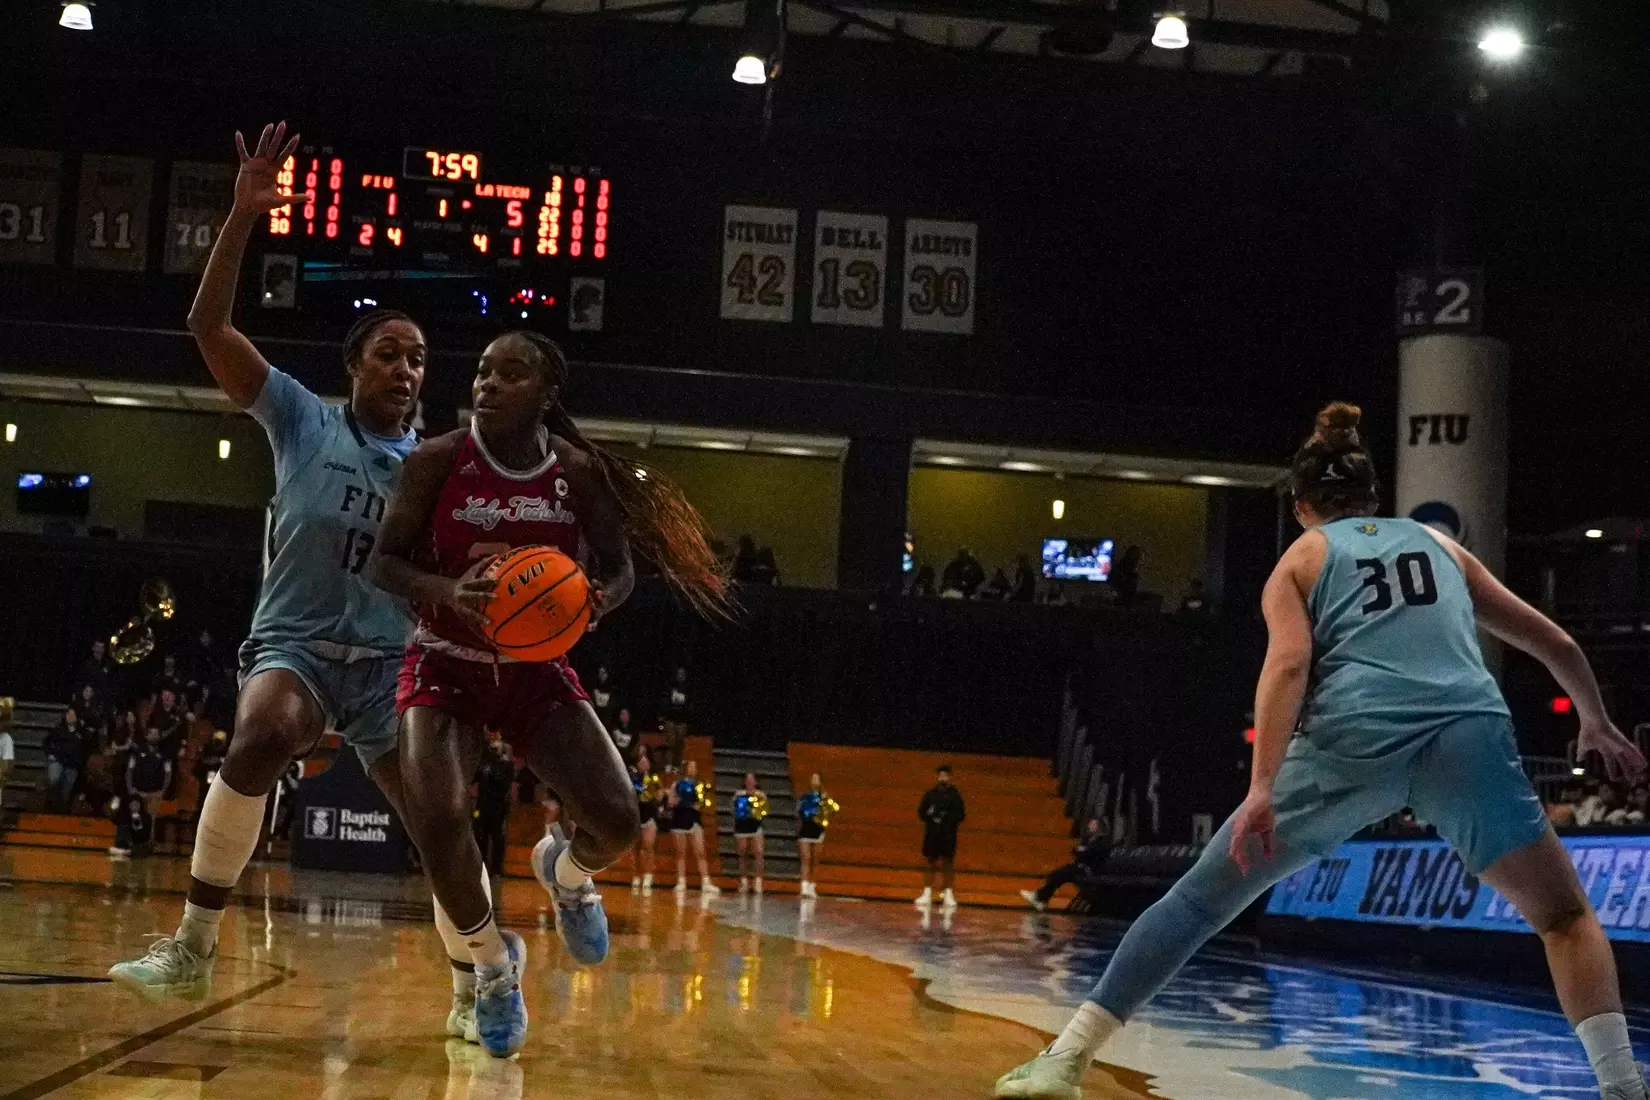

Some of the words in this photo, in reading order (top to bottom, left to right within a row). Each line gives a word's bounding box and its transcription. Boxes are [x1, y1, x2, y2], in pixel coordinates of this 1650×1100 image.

[330, 158, 342, 174] 0
[425, 150, 480, 180] 7:59
[305, 172, 317, 188] 0
[329, 174, 341, 190] 0
[361, 173, 397, 190] FIU
[474, 182, 495, 198] LA
[495, 184, 532, 200] TECH
[574, 177, 585, 194] 0
[303, 203, 315, 220] 0
[327, 205, 339, 221] 0
[387, 192, 398, 217] 1
[438, 198, 448, 219] 1
[597, 195, 608, 211] 0
[0, 202, 45, 243] 31
[505, 200, 525, 229] 5
[572, 209, 583, 225] 0
[596, 211, 607, 227] 0
[89, 211, 132, 249] 11
[269, 217, 291, 235] 30
[326, 221, 338, 238] 0
[359, 222, 375, 246] 2
[386, 226, 403, 247] 4
[571, 225, 582, 240] 0
[595, 226, 606, 242] 0
[727, 219, 795, 245] STEWART
[820, 226, 883, 250] BELL
[472, 233, 488, 254] 4
[512, 236, 522, 255] 1
[570, 241, 581, 257] 0
[594, 242, 605, 258] 0
[727, 253, 786, 307] 42
[816, 257, 880, 311] 13
[907, 265, 969, 317] 30
[1432, 279, 1471, 325] 2
[1408, 414, 1470, 445] FIU
[452, 495, 504, 530] Lady
[506, 560, 546, 598] EVO
[1355, 551, 1439, 615] 30
[339, 808, 391, 828] Baptist
[339, 825, 387, 842] Health
[1305, 858, 1352, 902] FIU
[1357, 847, 1480, 920] VAMOS
